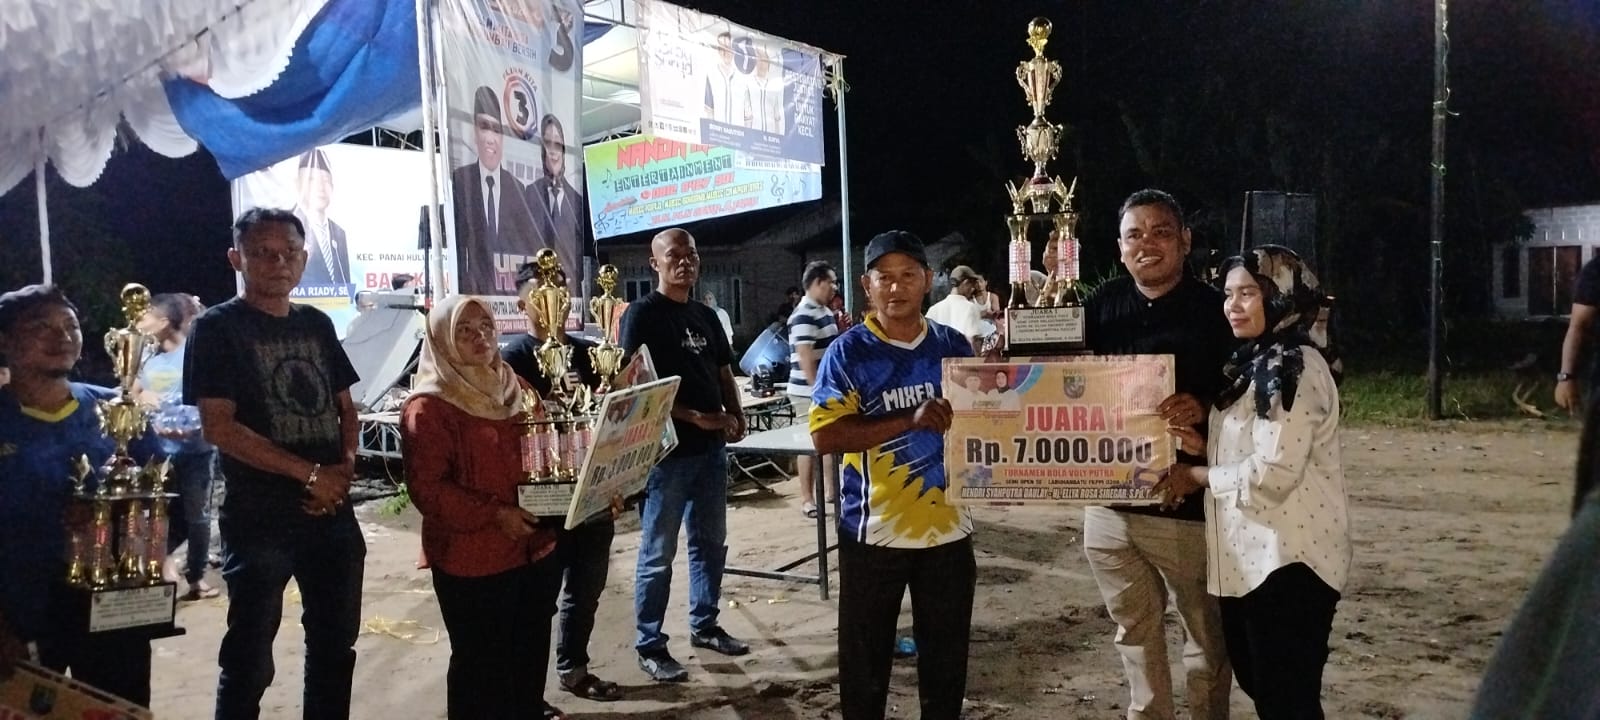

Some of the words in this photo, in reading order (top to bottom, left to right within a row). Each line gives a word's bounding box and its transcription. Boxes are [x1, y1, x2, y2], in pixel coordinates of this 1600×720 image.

[514, 90, 529, 126] 3
[614, 154, 733, 192] ENTERTAINMENT
[356, 253, 377, 261] KEC.
[379, 253, 404, 261] PANAI
[289, 286, 306, 296] RA
[308, 286, 337, 297] RIADY,
[882, 382, 935, 412] MIXER
[1025, 405, 1106, 431] JUARA
[1112, 405, 1124, 431] 1
[966, 437, 1008, 466] Rp.
[1013, 437, 1152, 464] 7.000.000
[1004, 468, 1045, 477] TURNAMEN
[1047, 468, 1067, 477] BOLA
[1089, 469, 1115, 477] PUTRA
[961, 487, 985, 498] HENDRI
[986, 487, 1023, 499] SYAHPUTRA
[1024, 487, 1047, 499] DAULAY
[1062, 487, 1079, 499] ELLYA
[1080, 487, 1098, 499] ROSA
